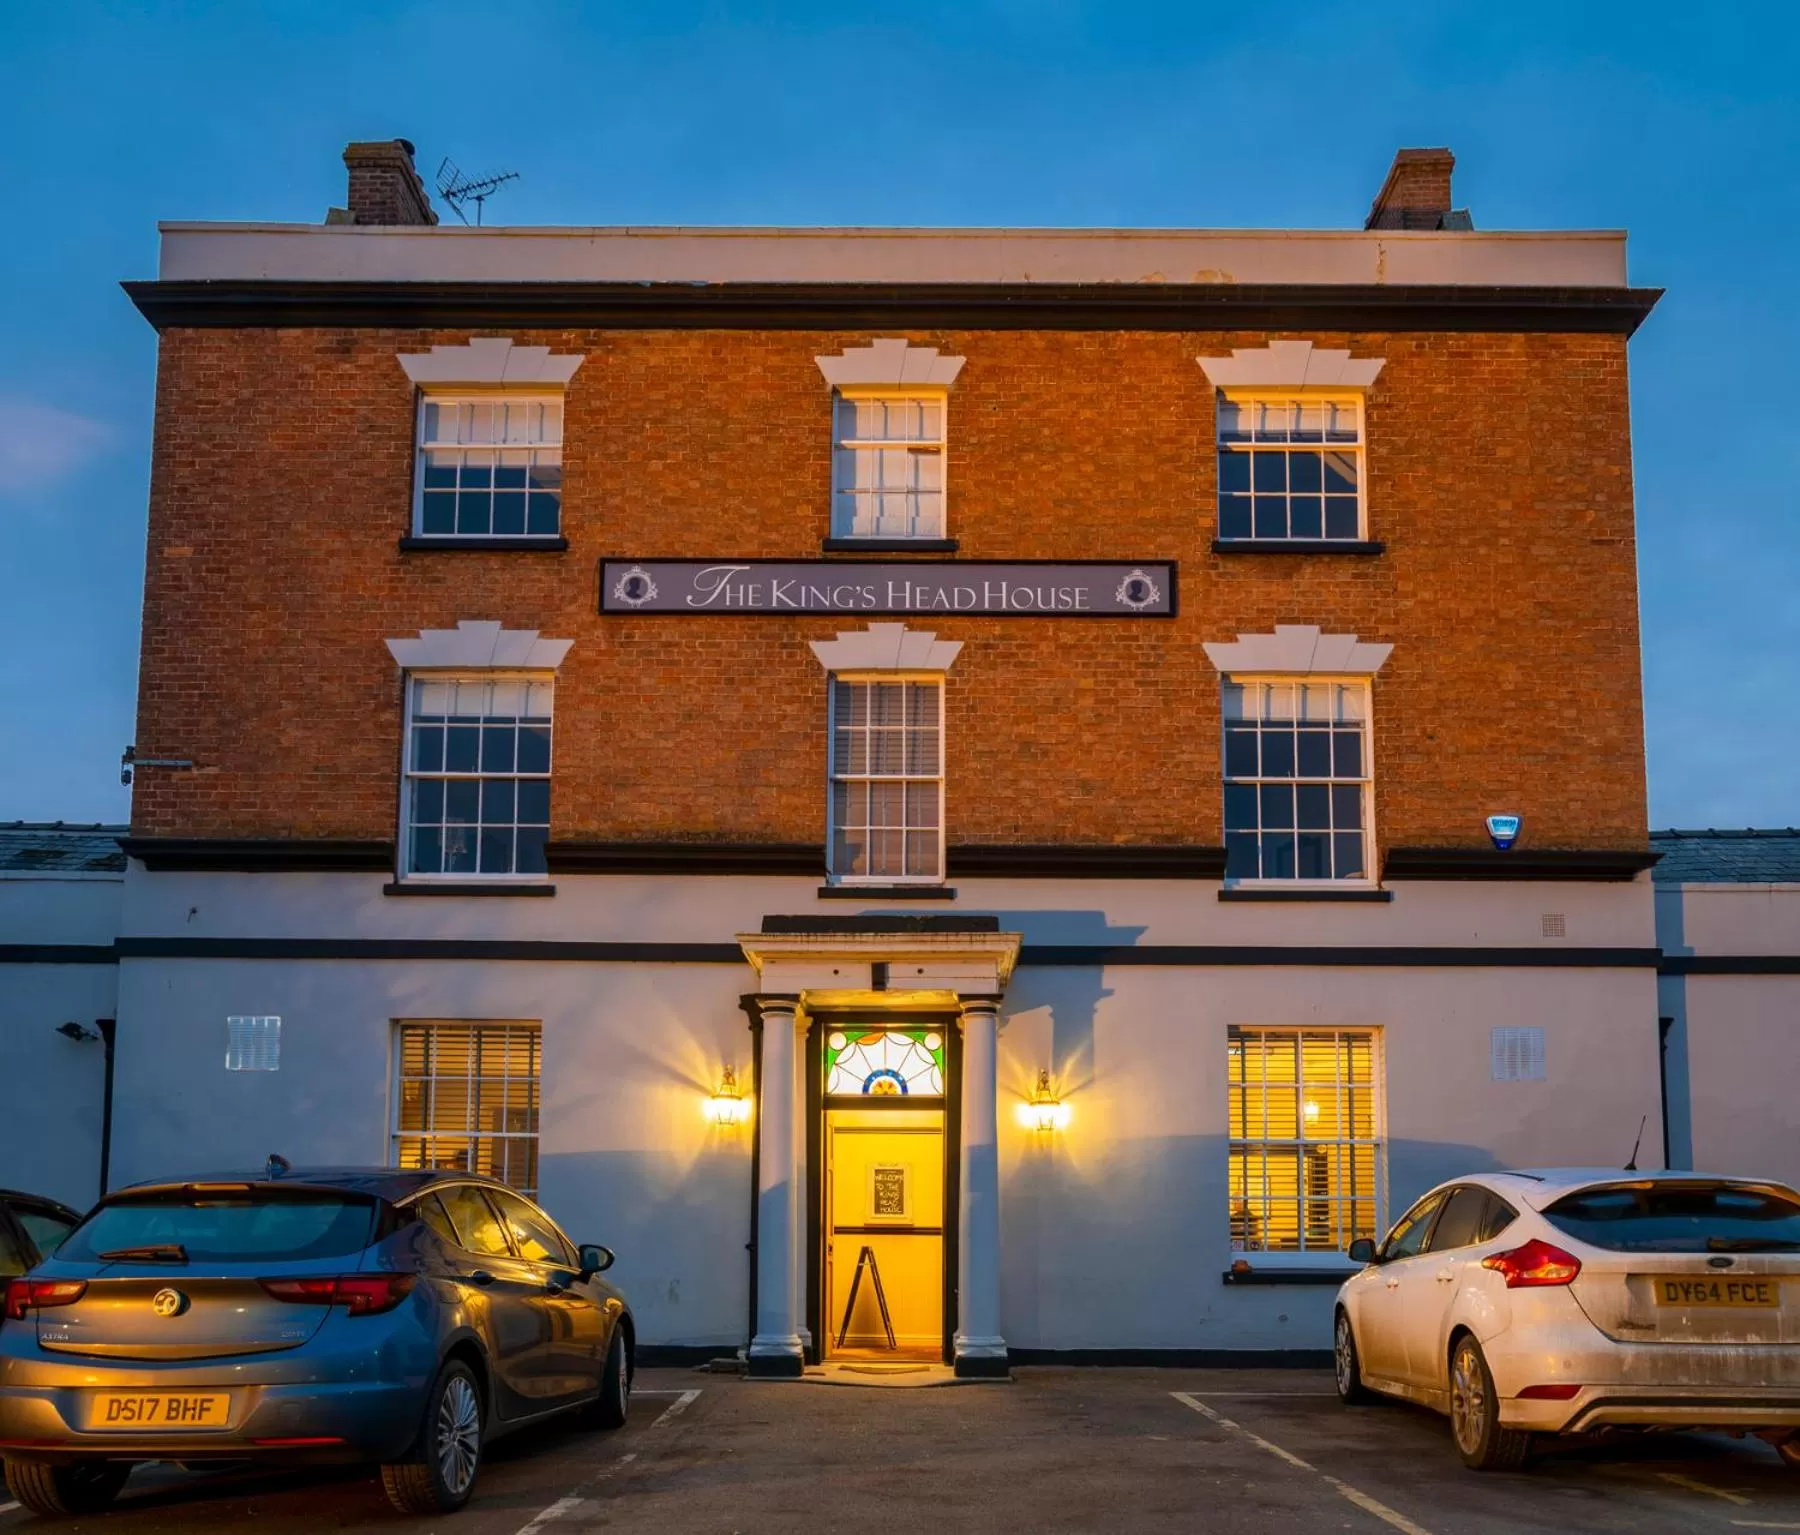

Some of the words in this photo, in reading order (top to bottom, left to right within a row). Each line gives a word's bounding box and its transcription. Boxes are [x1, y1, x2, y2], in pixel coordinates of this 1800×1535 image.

[887, 581, 976, 609] HEAD
[984, 581, 1090, 610] HOUSE
[1664, 1282, 1721, 1303] DY64
[1726, 1283, 1769, 1303] FCE
[105, 1398, 160, 1421] DS17
[165, 1398, 214, 1421] BHF
